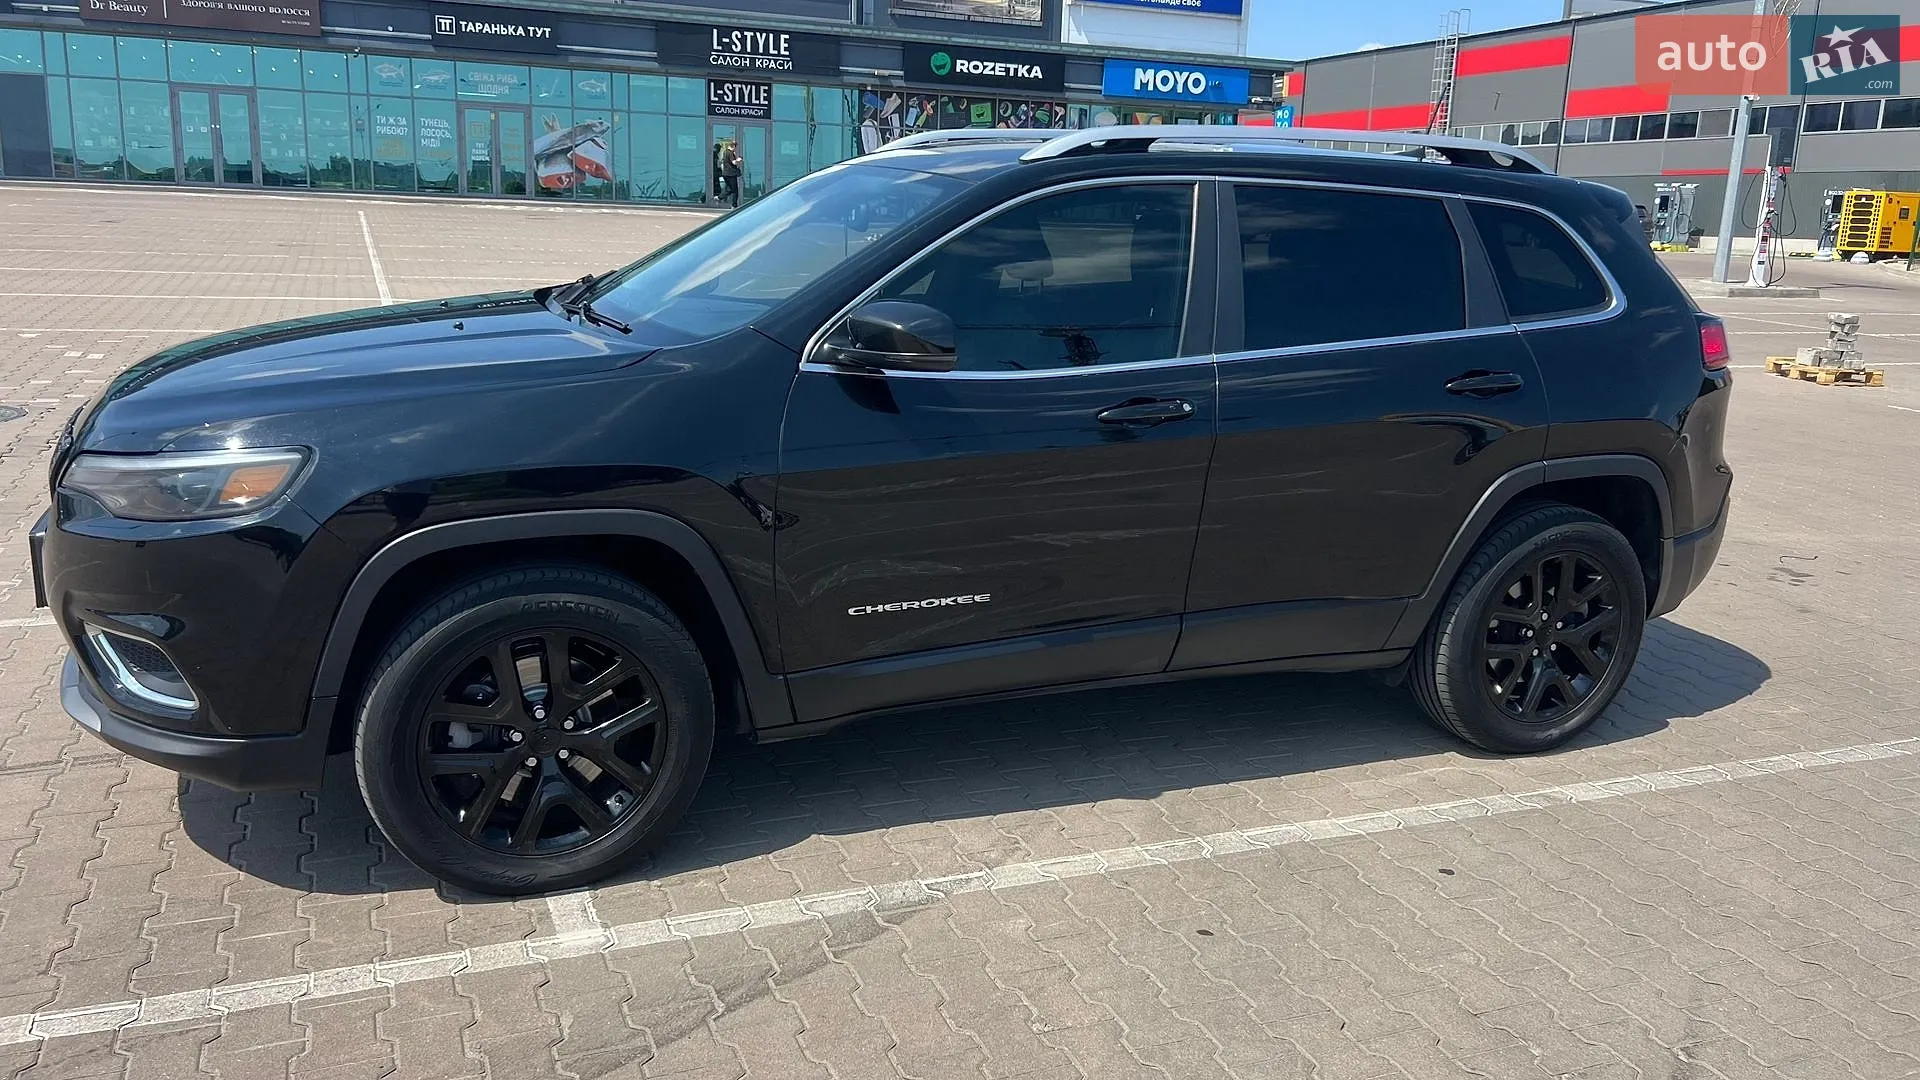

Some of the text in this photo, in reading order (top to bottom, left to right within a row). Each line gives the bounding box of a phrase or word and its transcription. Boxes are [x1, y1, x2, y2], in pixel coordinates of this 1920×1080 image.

[90, 0, 148, 17] Dr Beauty
[227, 3, 266, 13] ВАШОГО
[269, 6, 310, 17] ВОЛОССЯ
[459, 20, 526, 37] ТАРАНЬКА
[527, 26, 552, 39] ТУТ
[712, 28, 790, 55] L-STYLE
[709, 55, 793, 71] САЛОН КРАСИ
[955, 59, 1043, 79] ROZETKA
[496, 72, 518, 84] РИБА
[1133, 67, 1207, 95] MOYO
[478, 83, 510, 95] ЩОДНЯ
[710, 82, 769, 105] L-STYLE
[715, 106, 764, 116] САЛОН КРАСИ
[376, 115, 386, 125] ТИ
[397, 116, 407, 125] ЗА
[376, 125, 409, 136] РИБОЮ?
[847, 593, 991, 616] CHEROKEE
